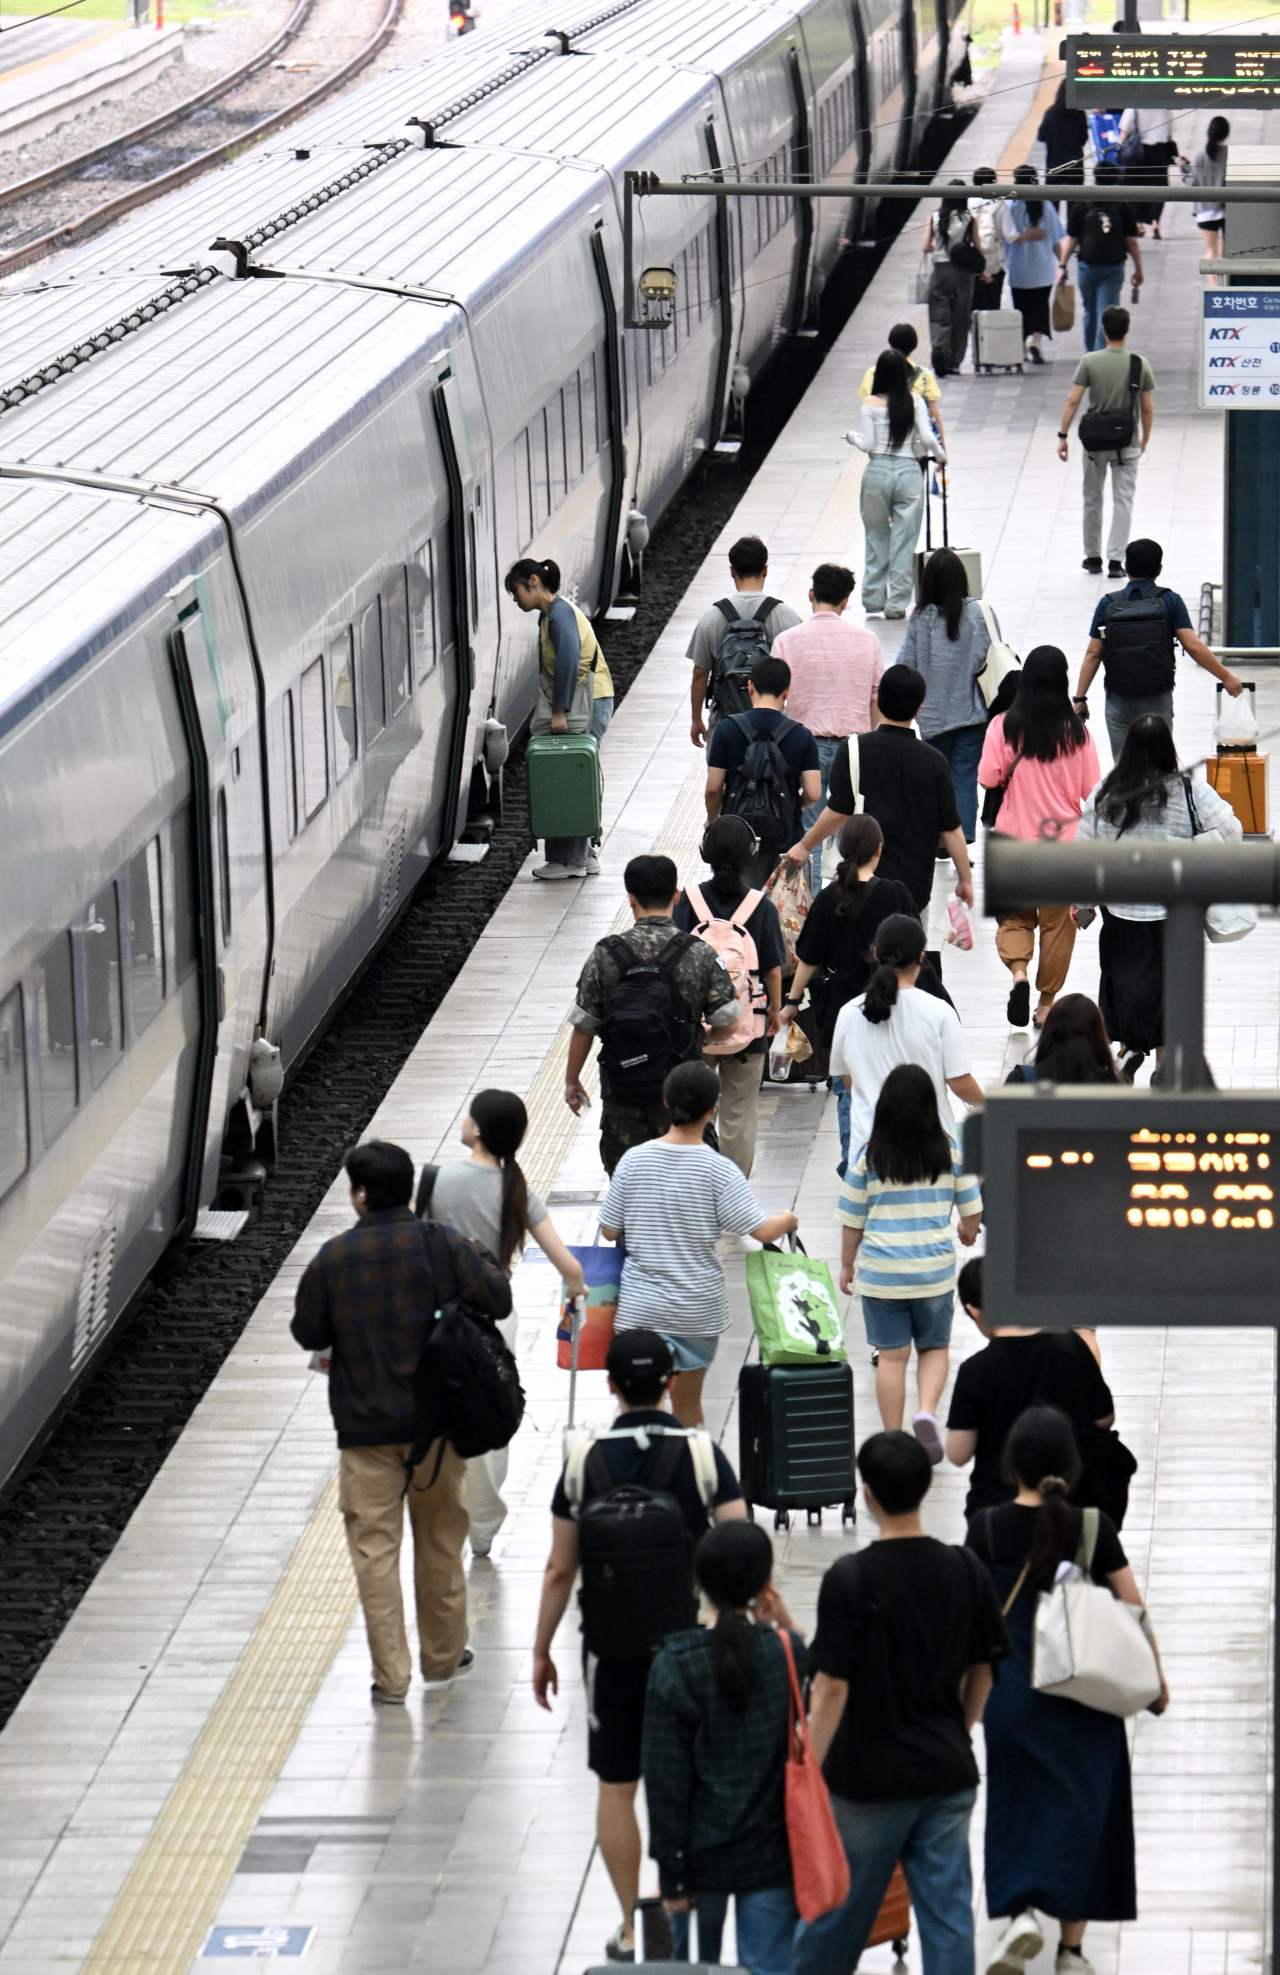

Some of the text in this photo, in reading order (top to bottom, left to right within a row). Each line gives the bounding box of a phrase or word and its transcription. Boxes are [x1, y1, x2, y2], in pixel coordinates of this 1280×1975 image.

[1211, 296, 1258, 310] 호차번호
[1209, 326, 1249, 340] KTX
[1209, 356, 1241, 368] KTX
[1209, 384, 1241, 396] KTX
